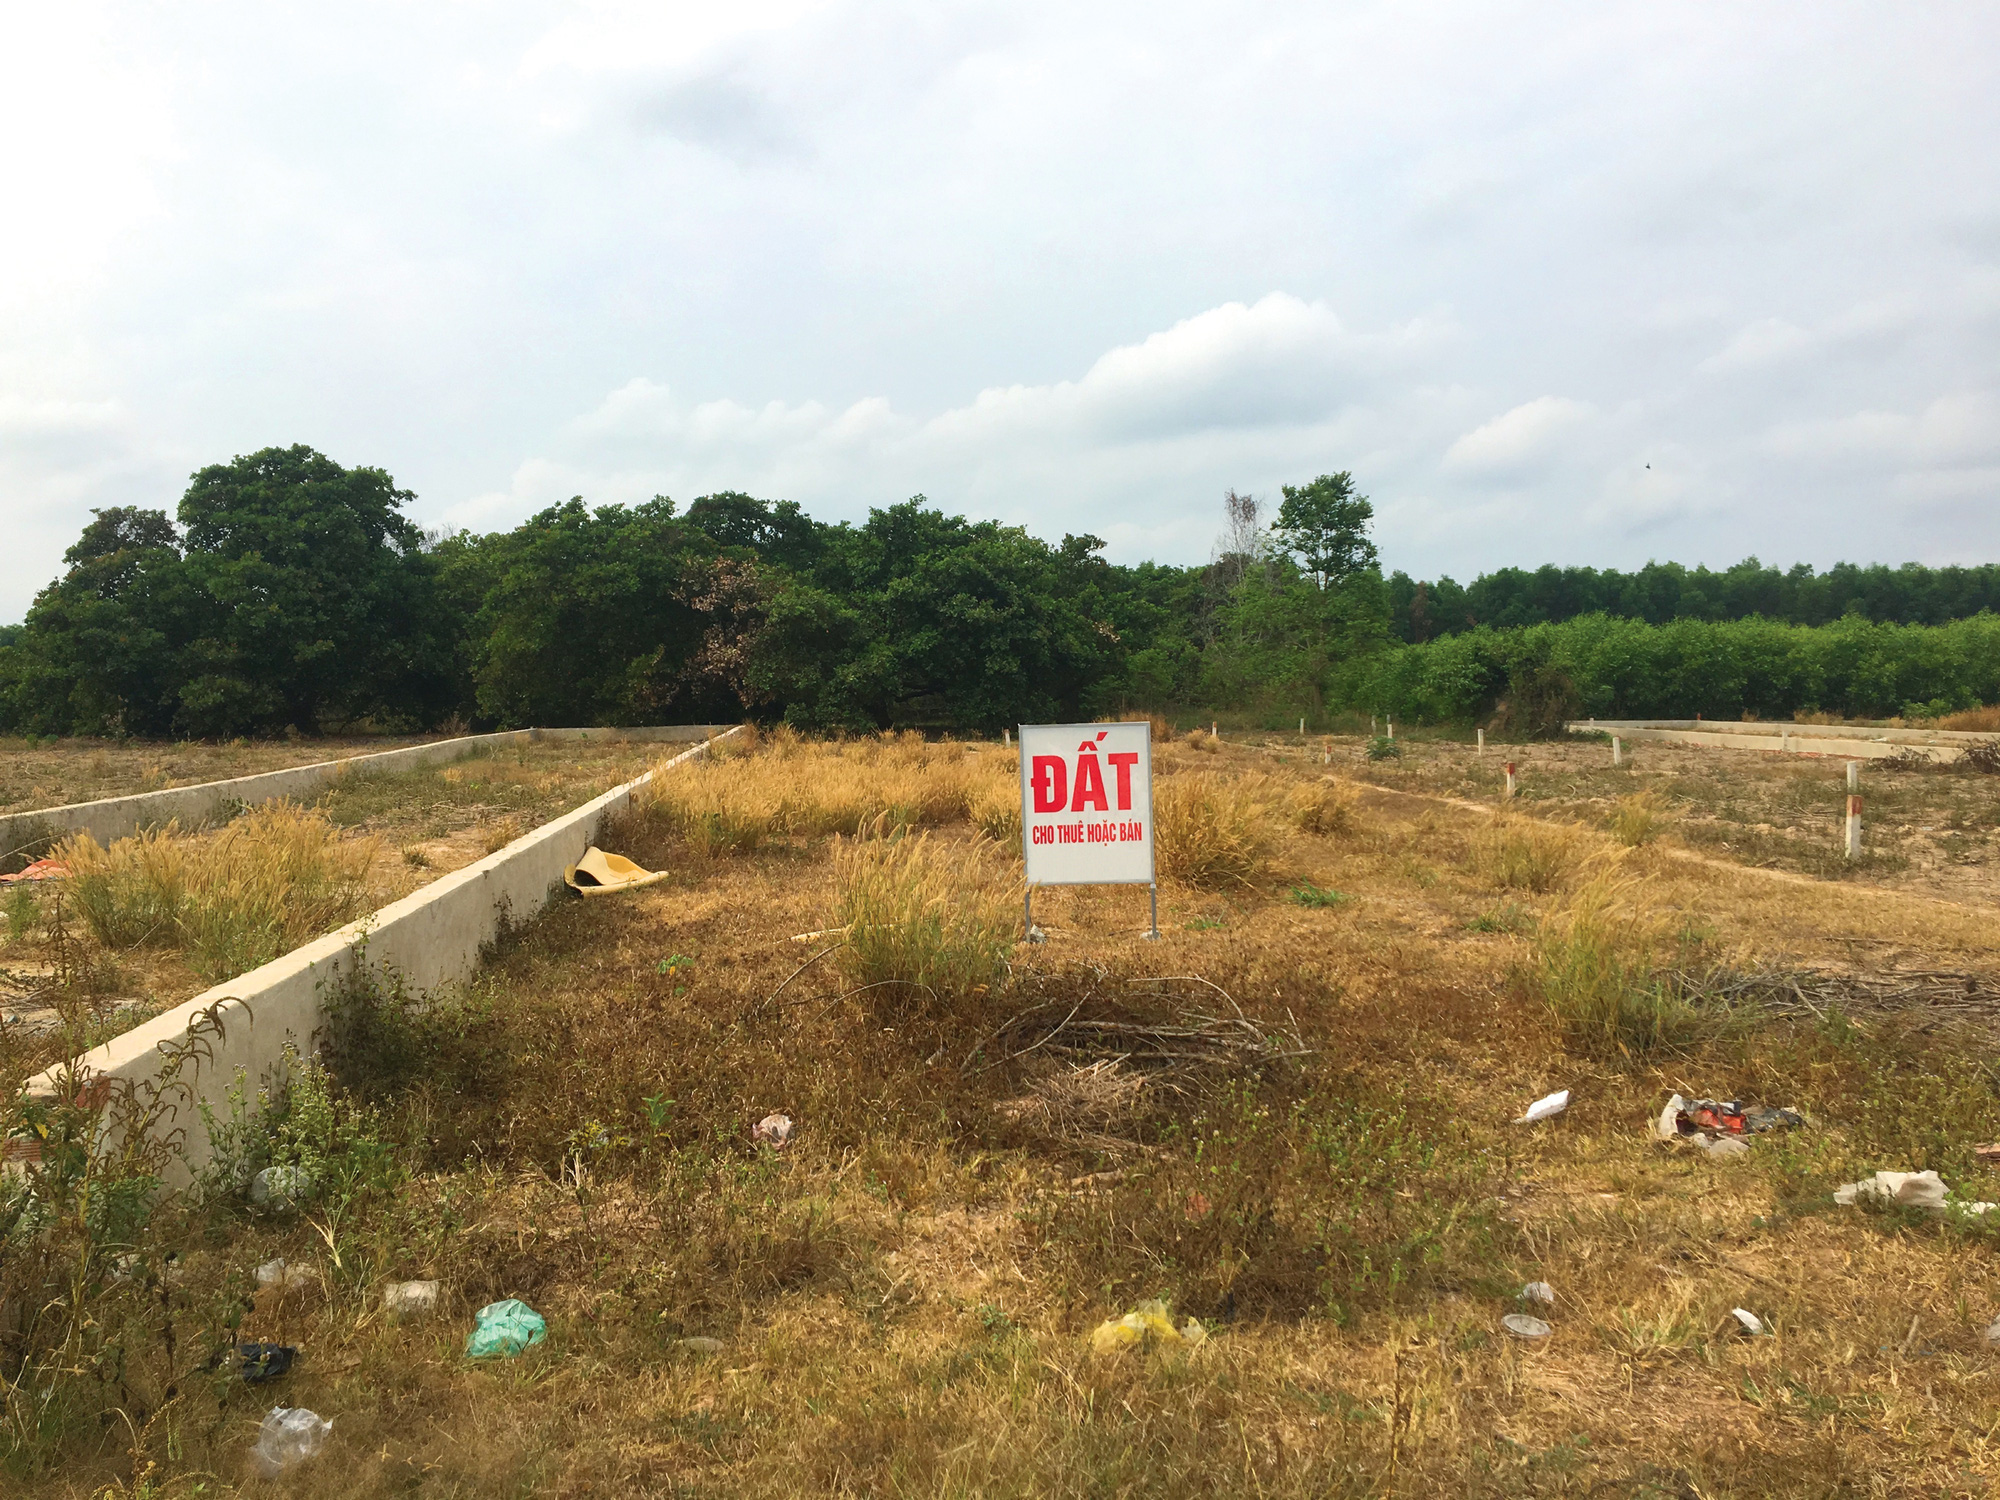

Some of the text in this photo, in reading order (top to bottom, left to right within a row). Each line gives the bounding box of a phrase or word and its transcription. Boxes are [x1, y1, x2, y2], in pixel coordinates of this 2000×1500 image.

[1031, 732, 1138, 813] ĐẤT
[1032, 819, 1142, 846] CHO THUÊ HOẶC BÁN
